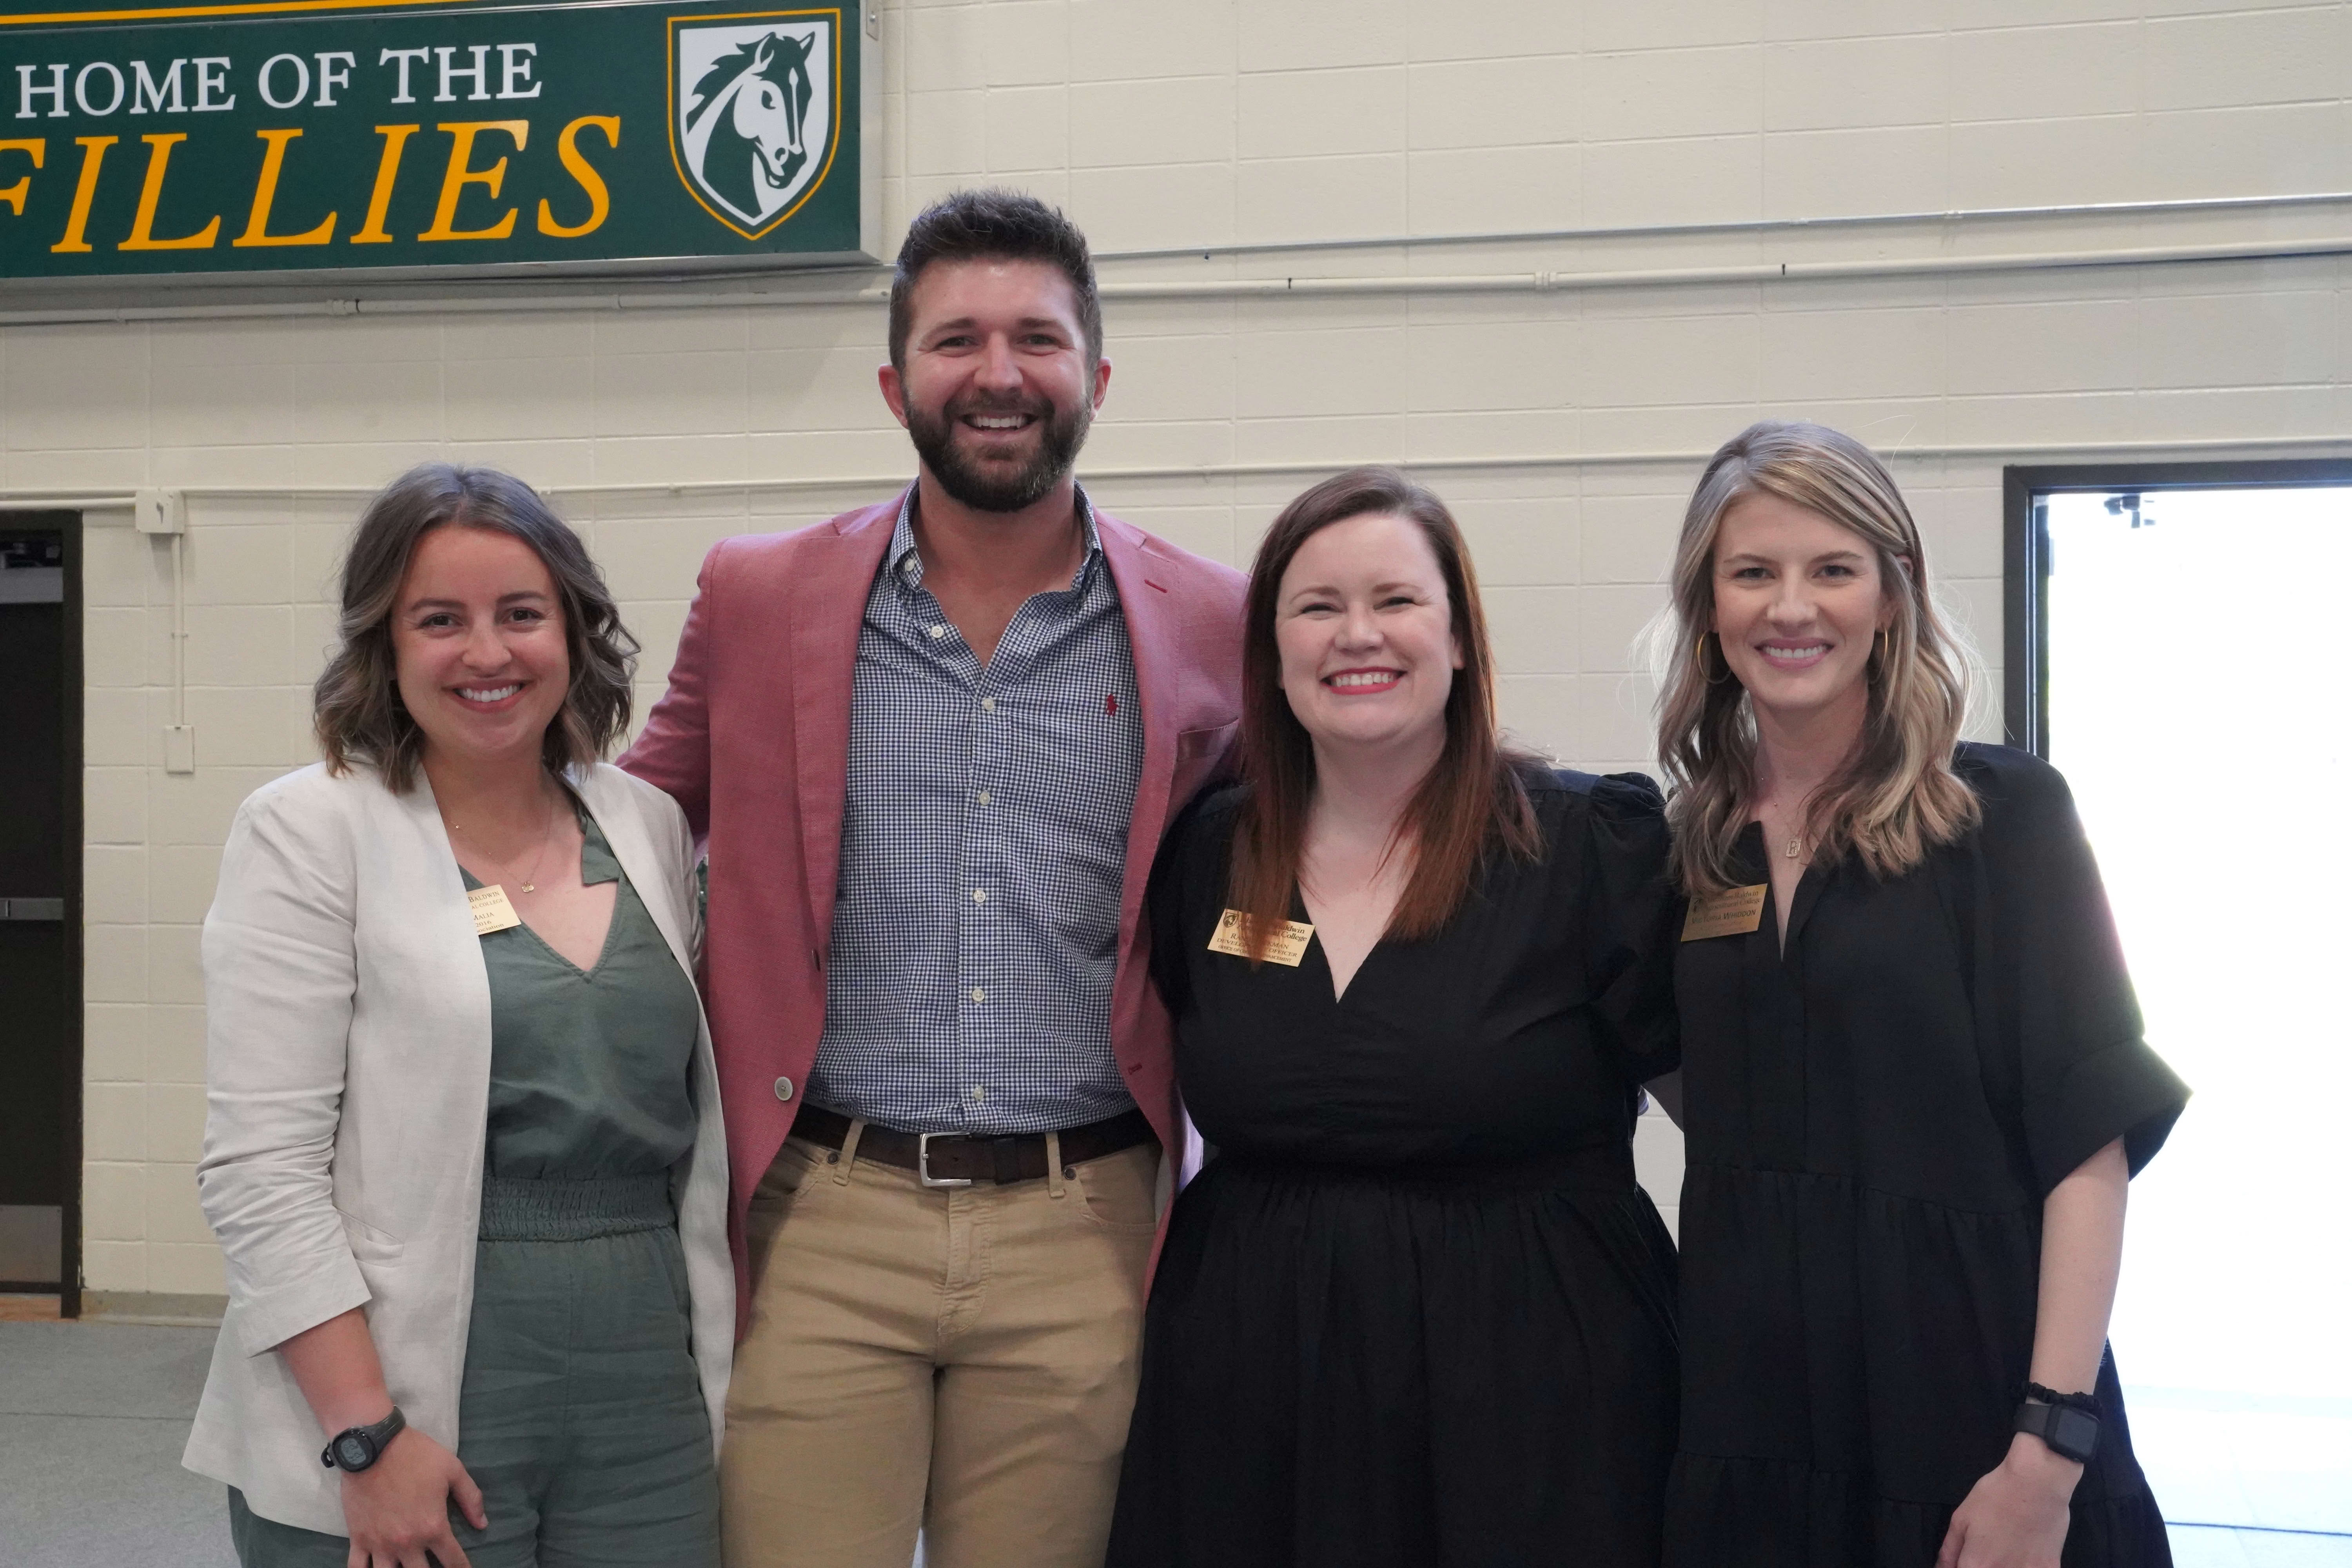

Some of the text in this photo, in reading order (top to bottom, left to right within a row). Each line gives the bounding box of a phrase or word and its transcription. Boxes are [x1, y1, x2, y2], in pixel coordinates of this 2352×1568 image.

[15, 43, 543, 118] HOME OF THE
[468, 891, 500, 903] BALDWIN
[479, 898, 504, 907] COLLEGE
[1281, 931, 1307, 942] College
[1269, 948, 1297, 957] OFFICER
